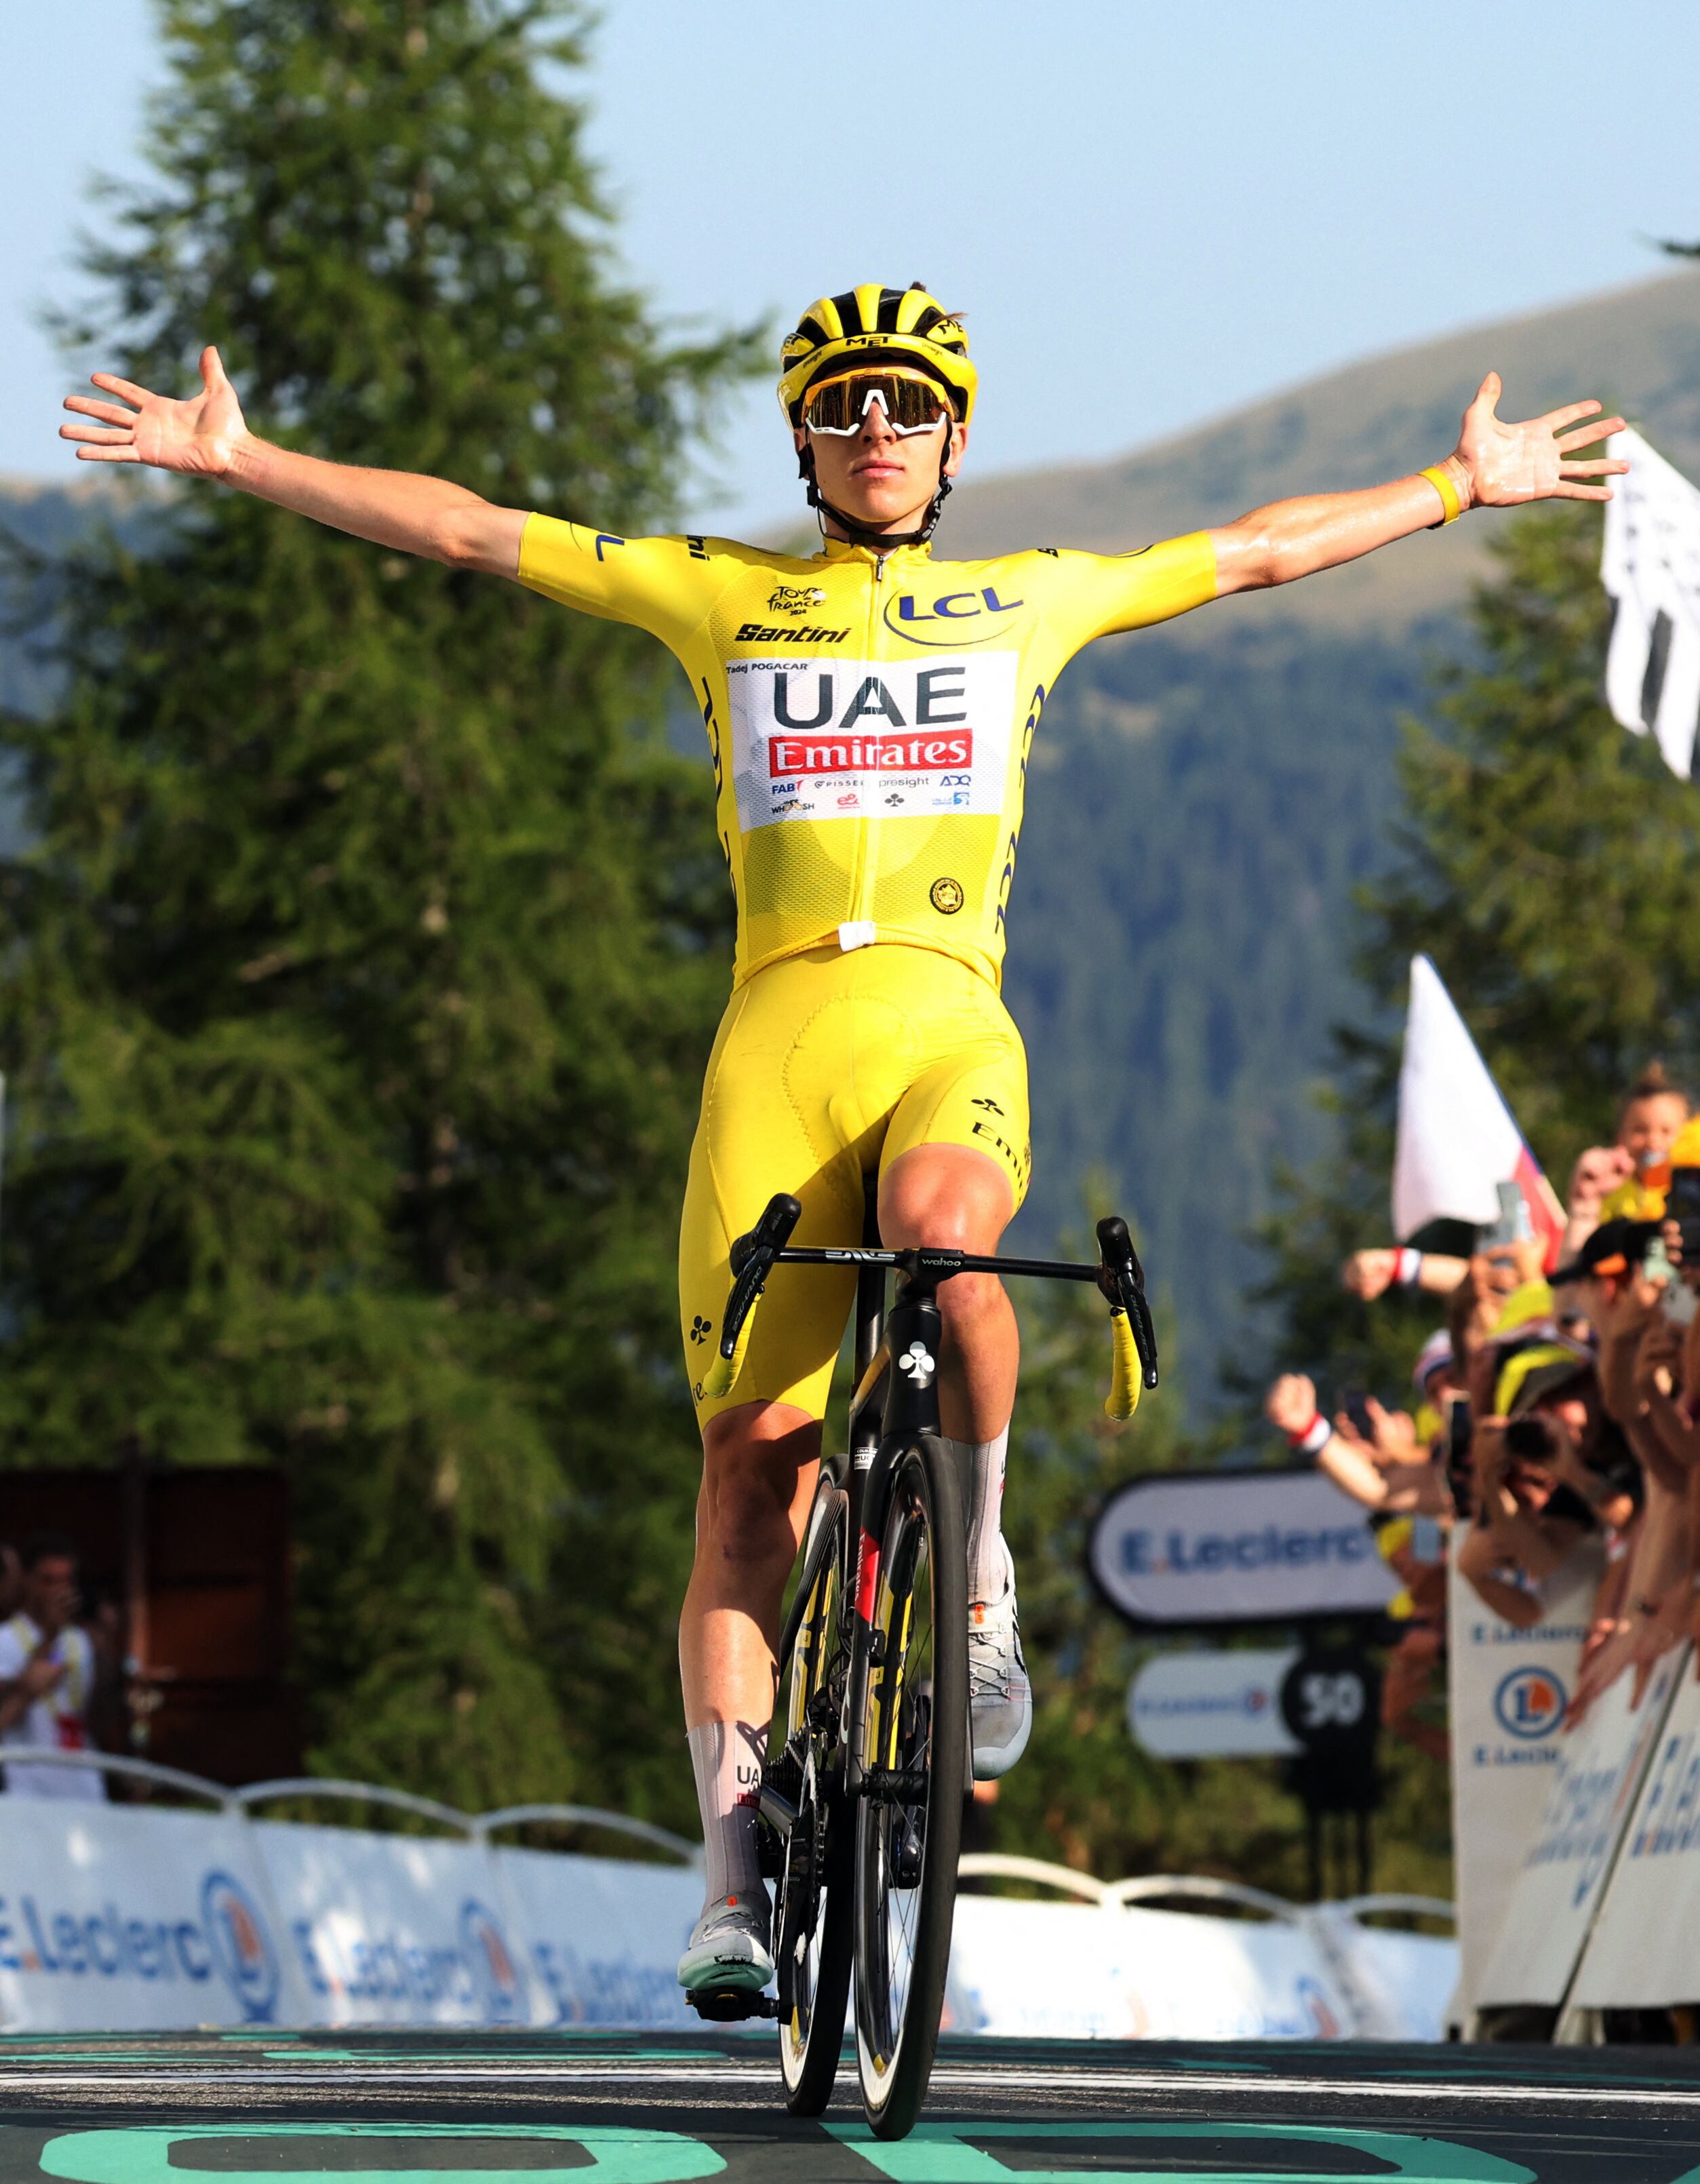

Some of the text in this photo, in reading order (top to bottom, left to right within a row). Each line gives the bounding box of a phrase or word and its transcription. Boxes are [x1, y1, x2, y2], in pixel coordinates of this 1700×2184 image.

[846, 336, 892, 347] MET
[899, 587, 1024, 621] LCL
[734, 624, 852, 643] Santini
[726, 662, 808, 674] Tadej POGACAR
[774, 667, 967, 730] UAE
[774, 738, 968, 771] Emirates
[772, 782, 795, 795] FAB
[879, 776, 929, 788] presight
[922, 1256, 962, 1267] wahoo
